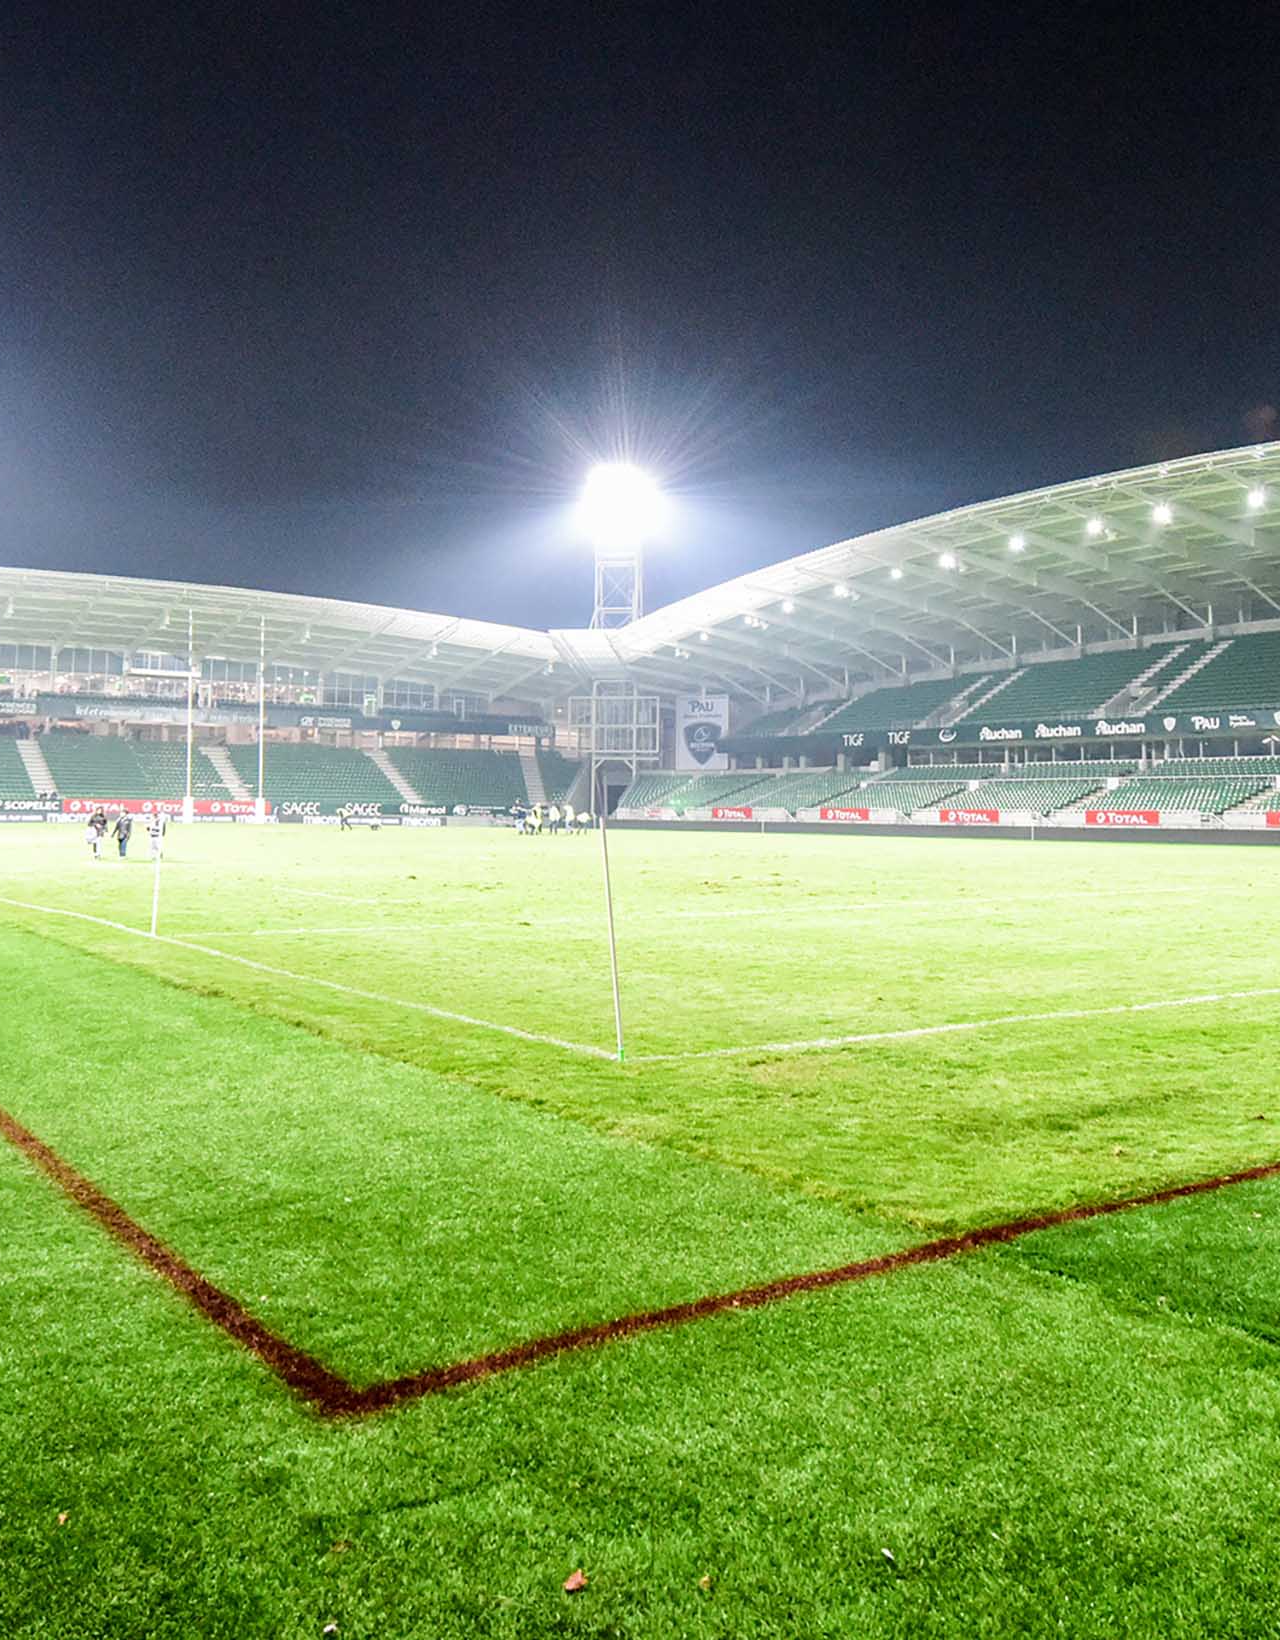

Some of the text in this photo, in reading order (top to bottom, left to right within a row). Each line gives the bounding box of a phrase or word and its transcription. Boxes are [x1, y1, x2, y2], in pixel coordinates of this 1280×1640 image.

[1096, 720, 1145, 735] Auchan
[1191, 716, 1219, 730] PAU
[979, 727, 1022, 741] Auchan
[1035, 724, 1081, 738] Auchan
[842, 734, 864, 746] TIGF
[888, 731, 911, 744] TIGF
[5, 800, 59, 811] SCOPELEC
[223, 803, 256, 813] TOTA
[282, 802, 320, 815] SAGEC
[345, 803, 382, 815] SAGEC
[408, 806, 446, 815] Marsol
[723, 810, 747, 818] TOTAL
[834, 809, 862, 819] TOTAL
[958, 811, 990, 822] TOTAL
[1107, 812, 1147, 823] TOTAL
